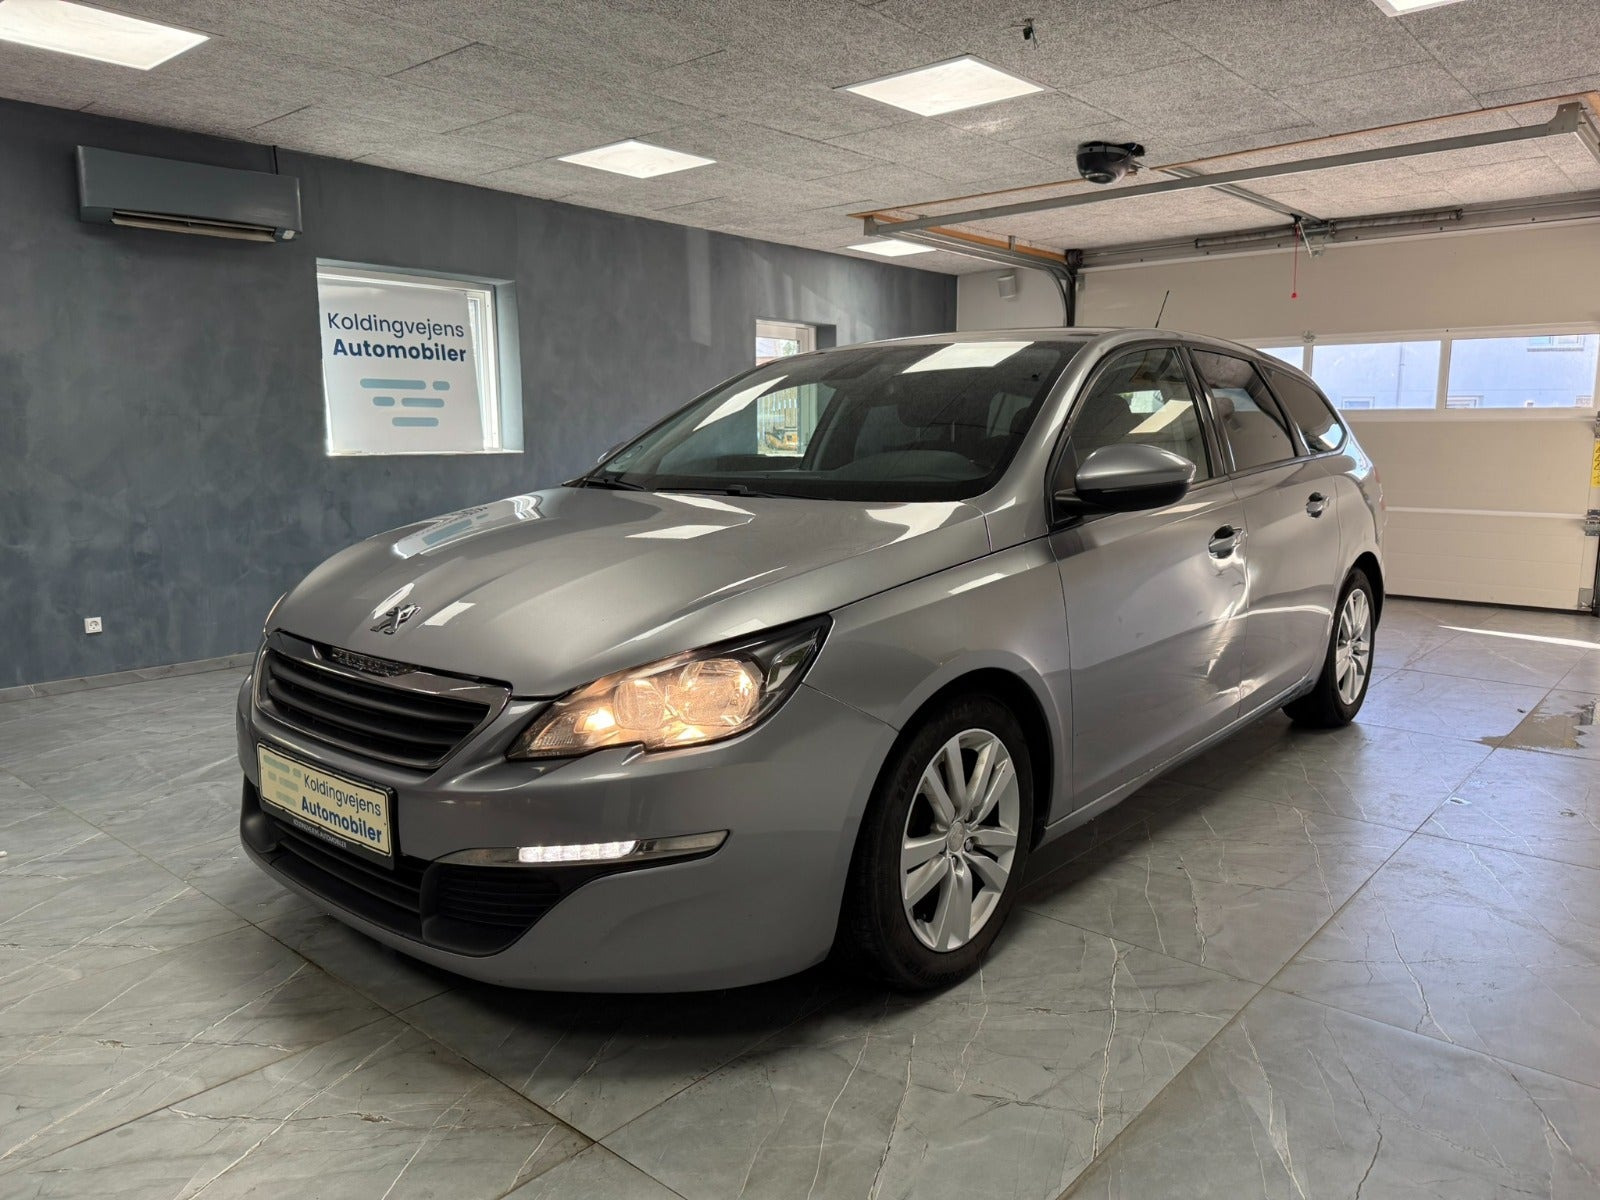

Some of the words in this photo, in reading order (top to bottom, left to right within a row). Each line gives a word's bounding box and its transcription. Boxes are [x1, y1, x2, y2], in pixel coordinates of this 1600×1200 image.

[328, 313, 465, 340] Koldingvejens
[333, 338, 467, 362] Automobiler
[304, 773, 381, 816] Koldingvejens
[302, 796, 382, 843] Automobiler
